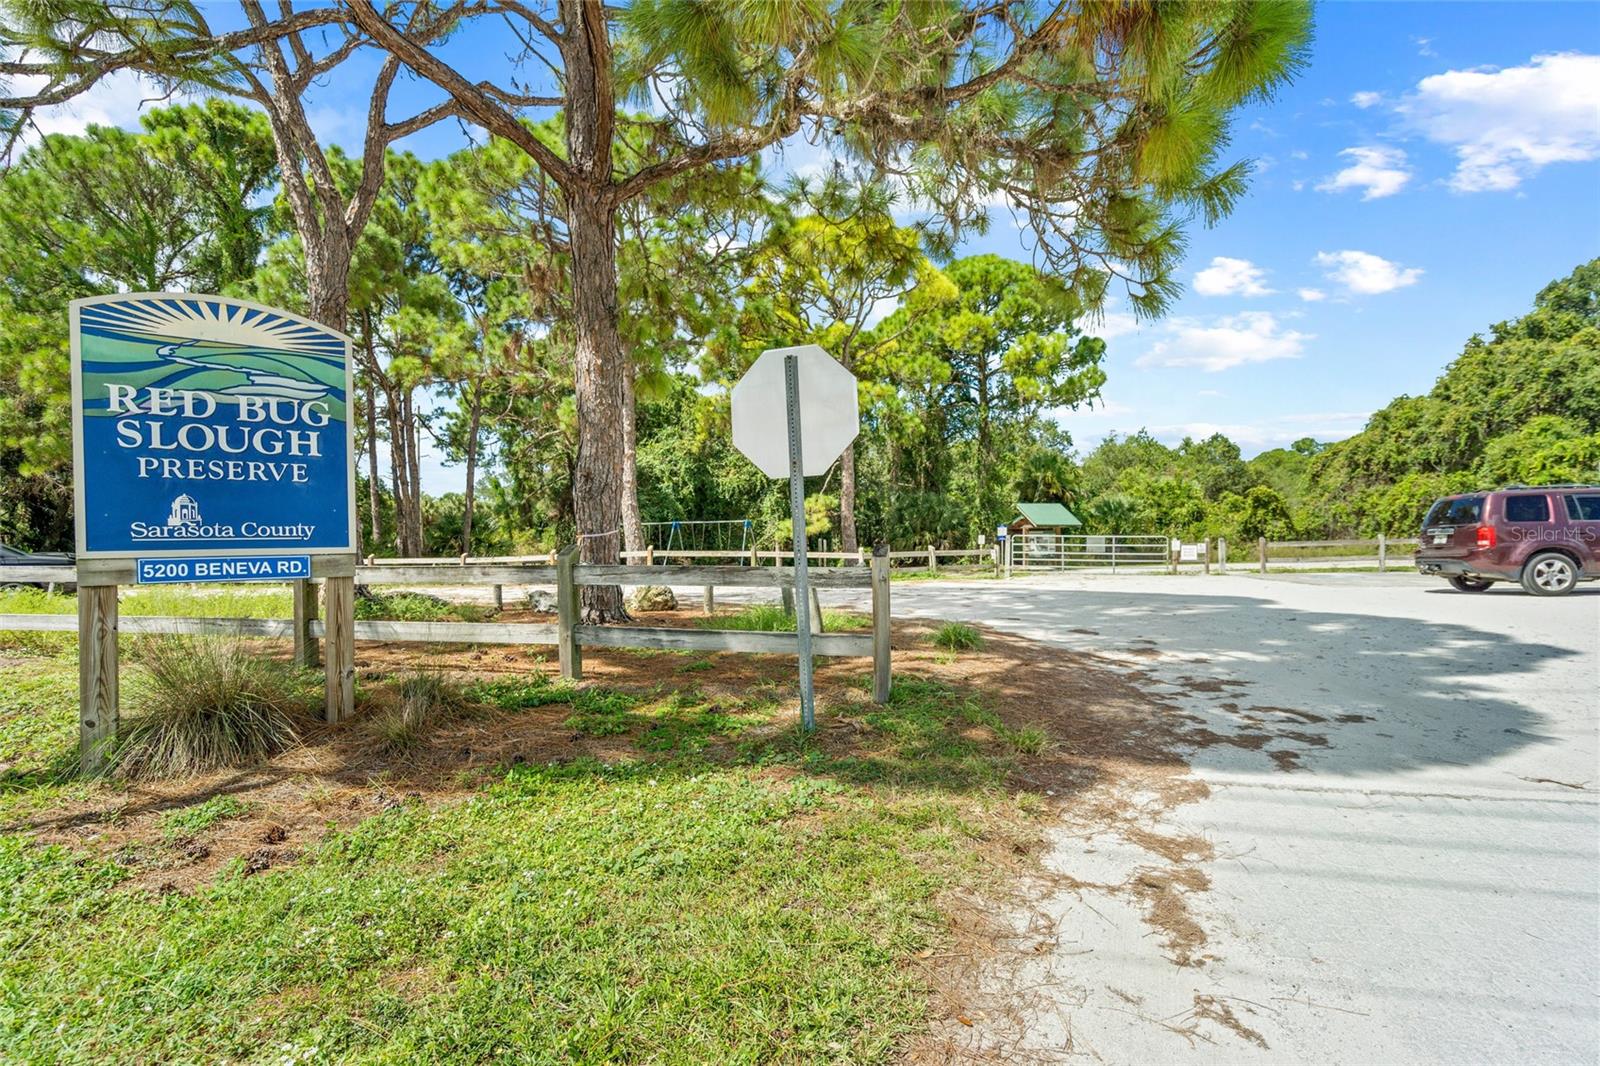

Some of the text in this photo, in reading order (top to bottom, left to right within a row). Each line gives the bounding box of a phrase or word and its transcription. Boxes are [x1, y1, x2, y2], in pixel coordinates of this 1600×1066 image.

[104, 383, 331, 426] RED BUG
[117, 420, 322, 457] SLOUGH
[137, 457, 309, 483] PRESERVE
[130, 521, 316, 540] Sarasota County
[143, 560, 307, 578] 5200 BENEVA RD.
